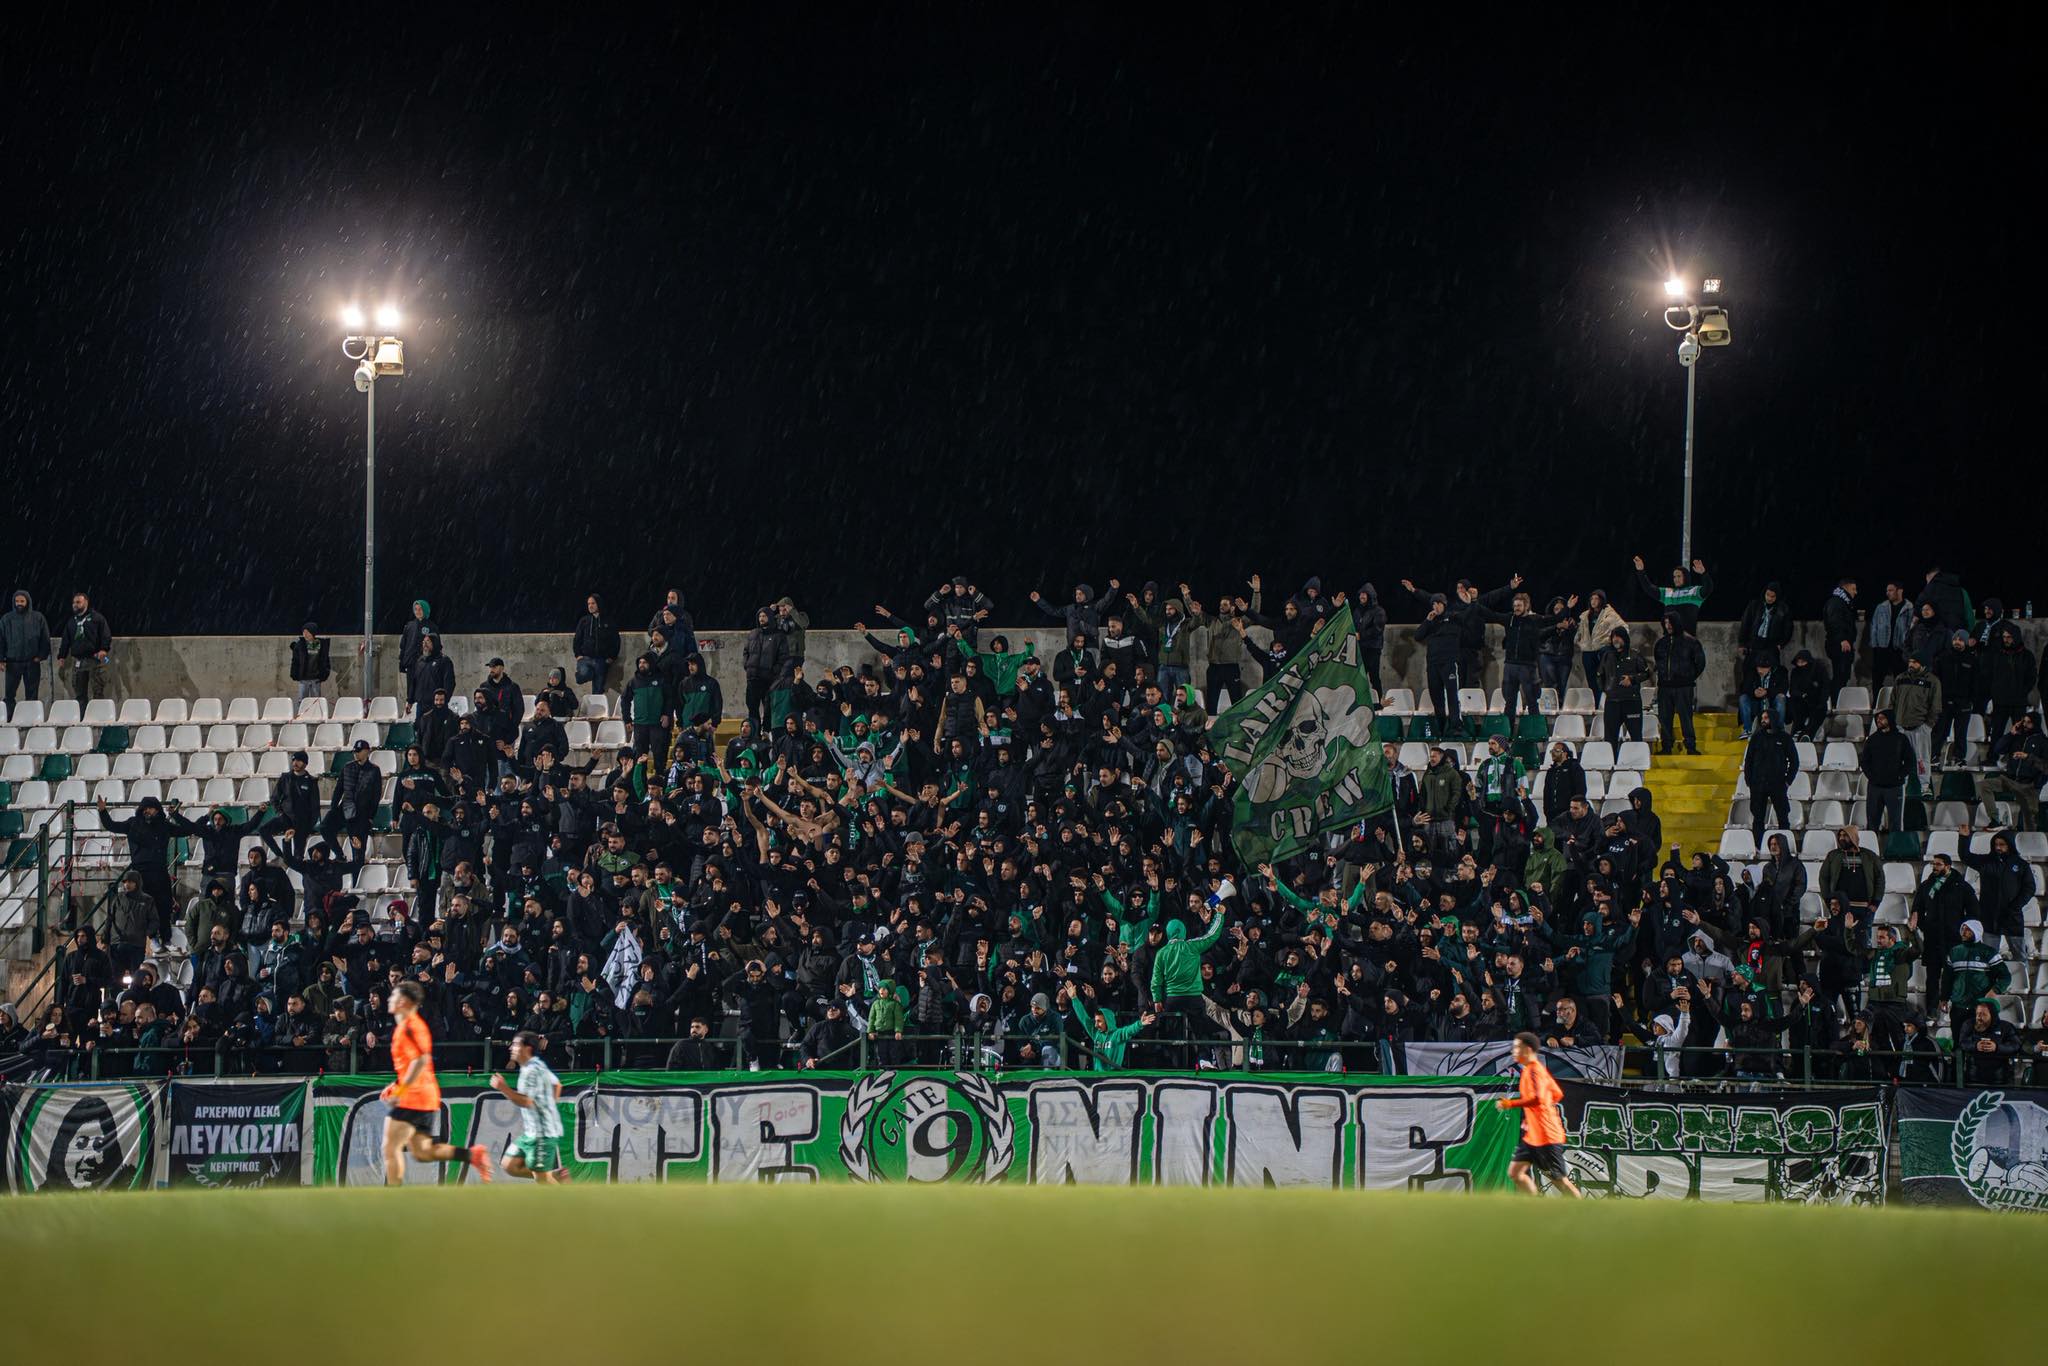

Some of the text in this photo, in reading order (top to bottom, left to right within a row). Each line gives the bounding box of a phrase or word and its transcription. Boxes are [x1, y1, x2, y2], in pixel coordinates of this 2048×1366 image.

[1270, 767, 1363, 841] CREW
[171, 1123, 299, 1154] ΛΕΥΚΩΣΙΑ
[194, 1105, 280, 1118] ΑΡΧΕΡΜΟΥ ΔΕΚΑ
[880, 1086, 944, 1146] GATE
[1029, 1079, 1475, 1190] NINE
[209, 1161, 260, 1172] ΚΕΝΤΡΙΚΟΣ
[912, 1111, 973, 1184] 9
